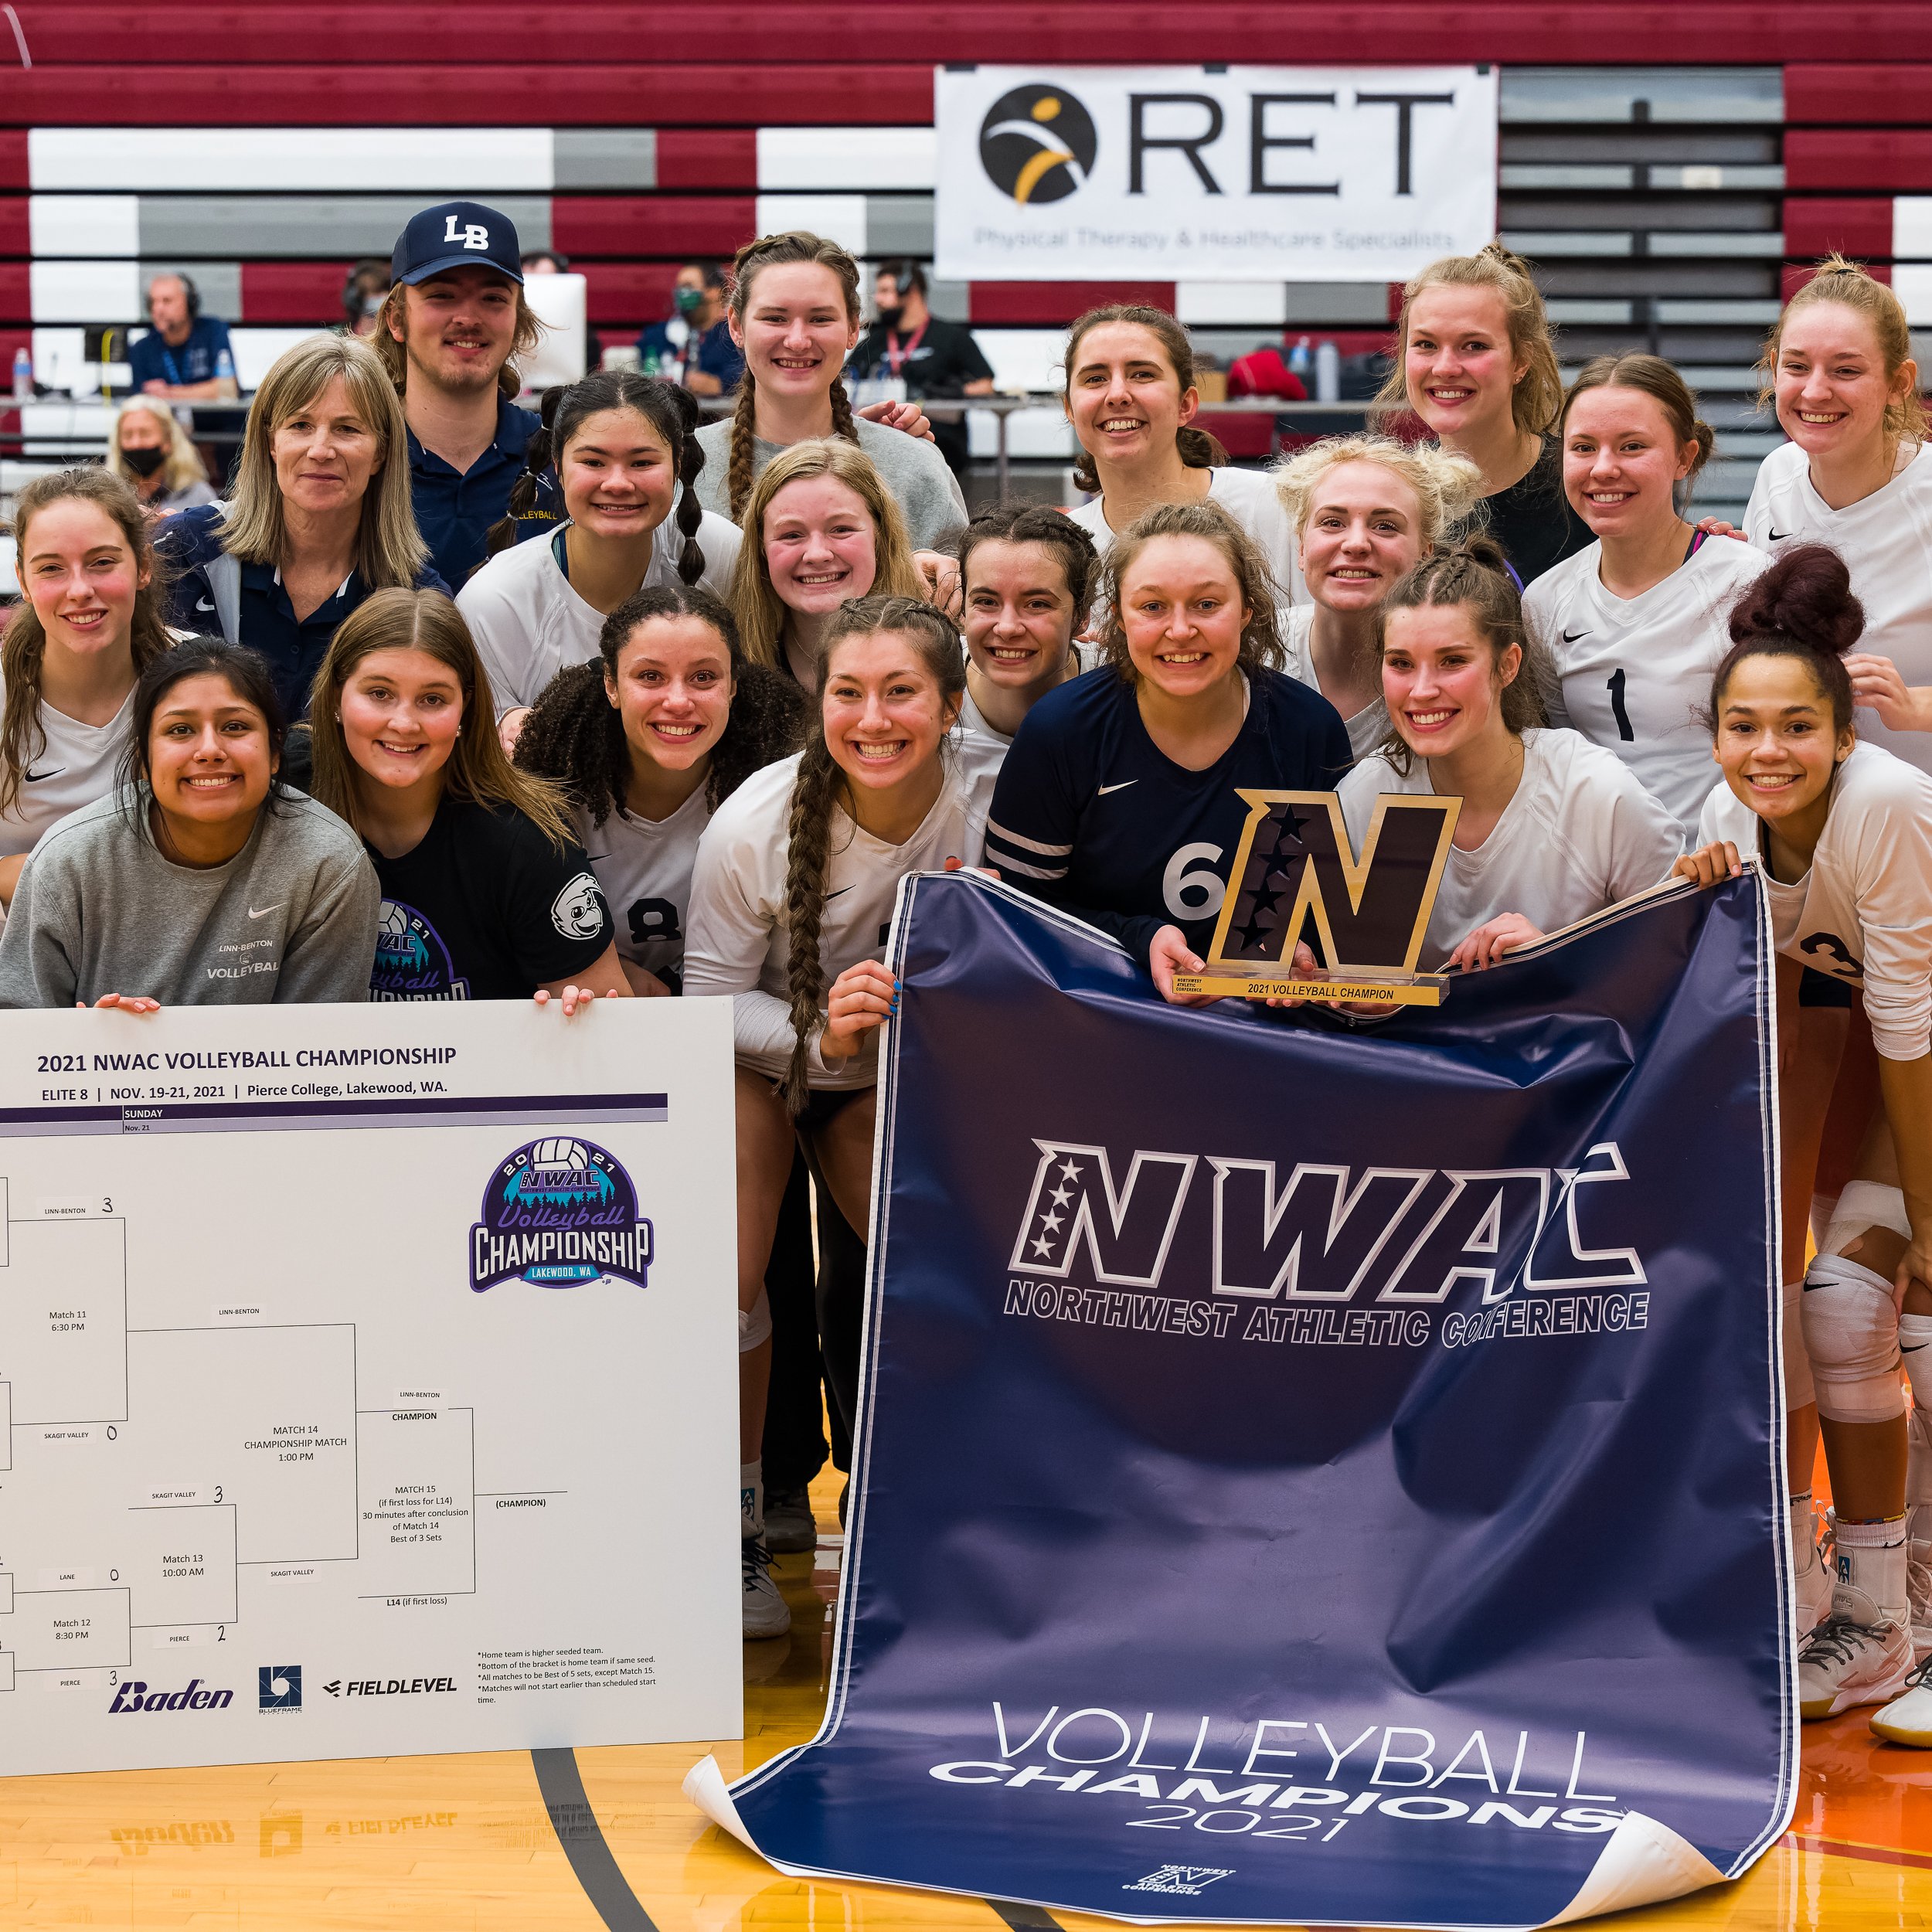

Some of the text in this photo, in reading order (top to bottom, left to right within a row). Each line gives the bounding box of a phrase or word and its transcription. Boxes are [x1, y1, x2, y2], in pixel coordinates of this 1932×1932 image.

[1127, 92, 1455, 196] RET
[444, 215, 489, 250] LB
[975, 226, 1456, 251] Physical Therapy & Healthcare Specialists
[519, 510, 557, 520] LEYBALL
[1606, 667, 1636, 742] 1
[1162, 842, 1226, 920] 6
[219, 940, 274, 952] LINN-BENTON
[207, 961, 279, 979] VOLLEYBAL
[1247, 983, 1395, 1000] 2021 VOLLEYBALL CHAMPION
[37, 1046, 457, 1073] 2021 NWAC VOLLEYBALL CHAMPIONSHIP
[42, 1080, 448, 1101] ELITE 8 NOV. 19-21, 2021 Pierce College, Lakewood, WA.
[124, 1109, 164, 1119] SUNDAY
[517, 1169, 600, 1189] NWAC
[101, 1196, 114, 1213] 3
[497, 1205, 626, 1231] Volleyball
[1007, 1138, 1648, 1304] NWAC
[475, 1223, 649, 1281] CHAMPIONSHIP
[531, 1267, 592, 1278] LAKEWOOD, WA
[49, 1310, 87, 1320] Match 11
[218, 1308, 260, 1316] LINN-BENTON
[1004, 1280, 1239, 1338] NORTHWEST
[1243, 1303, 1430, 1347] ATHLETIC
[51, 1322, 85, 1332] 6:30 PM
[392, 1412, 437, 1421] CHAMPION
[273, 1425, 319, 1435] MATCH 14
[243, 1437, 348, 1450] CHAMPIONSHIP MATCH
[278, 1452, 315, 1462] 1:00 PM
[152, 1492, 173, 1500] SKAGIT
[213, 1486, 223, 1503] 3
[394, 1485, 437, 1495] MATCH 15
[378, 1495, 453, 1509] (if first loss for L14)
[495, 1498, 546, 1510] (CHAMPION)
[362, 1508, 469, 1520] 30 minutes after conclusion
[392, 1521, 440, 1532] of Match 14
[390, 1533, 443, 1543] Best of 3 Sets
[162, 1553, 204, 1564] Match 13
[162, 1567, 205, 1578] 10:00 AM
[292, 1568, 314, 1577] VALLEY
[53, 1618, 91, 1628] Match 12
[55, 1631, 89, 1641] 8:30 PM
[168, 1634, 190, 1643] PIERCE
[217, 1625, 226, 1642] 2
[525, 1649, 530, 1658] is
[532, 1648, 554, 1658] higher
[556, 1647, 581, 1656] seeded
[509, 1661, 517, 1669] of
[519, 1660, 531, 1668] the
[532, 1659, 559, 1668] bracket
[568, 1658, 588, 1667] home
[610, 1656, 615, 1665] if
[637, 1655, 655, 1664] seed.
[109, 1670, 117, 1686] 3
[492, 1672, 522, 1681] matches
[545, 1671, 560, 1679] Best
[561, 1669, 569, 1679] of
[577, 1670, 594, 1679] sets,
[594, 1669, 619, 1678] except
[645, 1666, 655, 1675] 15.
[346, 1677, 457, 1696] FIELDLEVEL
[514, 1682, 526, 1692] will
[560, 1681, 583, 1689] earlier
[603, 1679, 638, 1688] scheduled
[640, 1678, 656, 1686] start
[992, 1701, 1617, 1803] VOLLEYBALL
[927, 1760, 1625, 1835] CHAMPIONS
[1125, 1804, 1348, 1843] 2021
[1160, 1864, 1236, 1874] NORTHWEST
[1121, 1884, 1202, 1896] CONFERENCE
